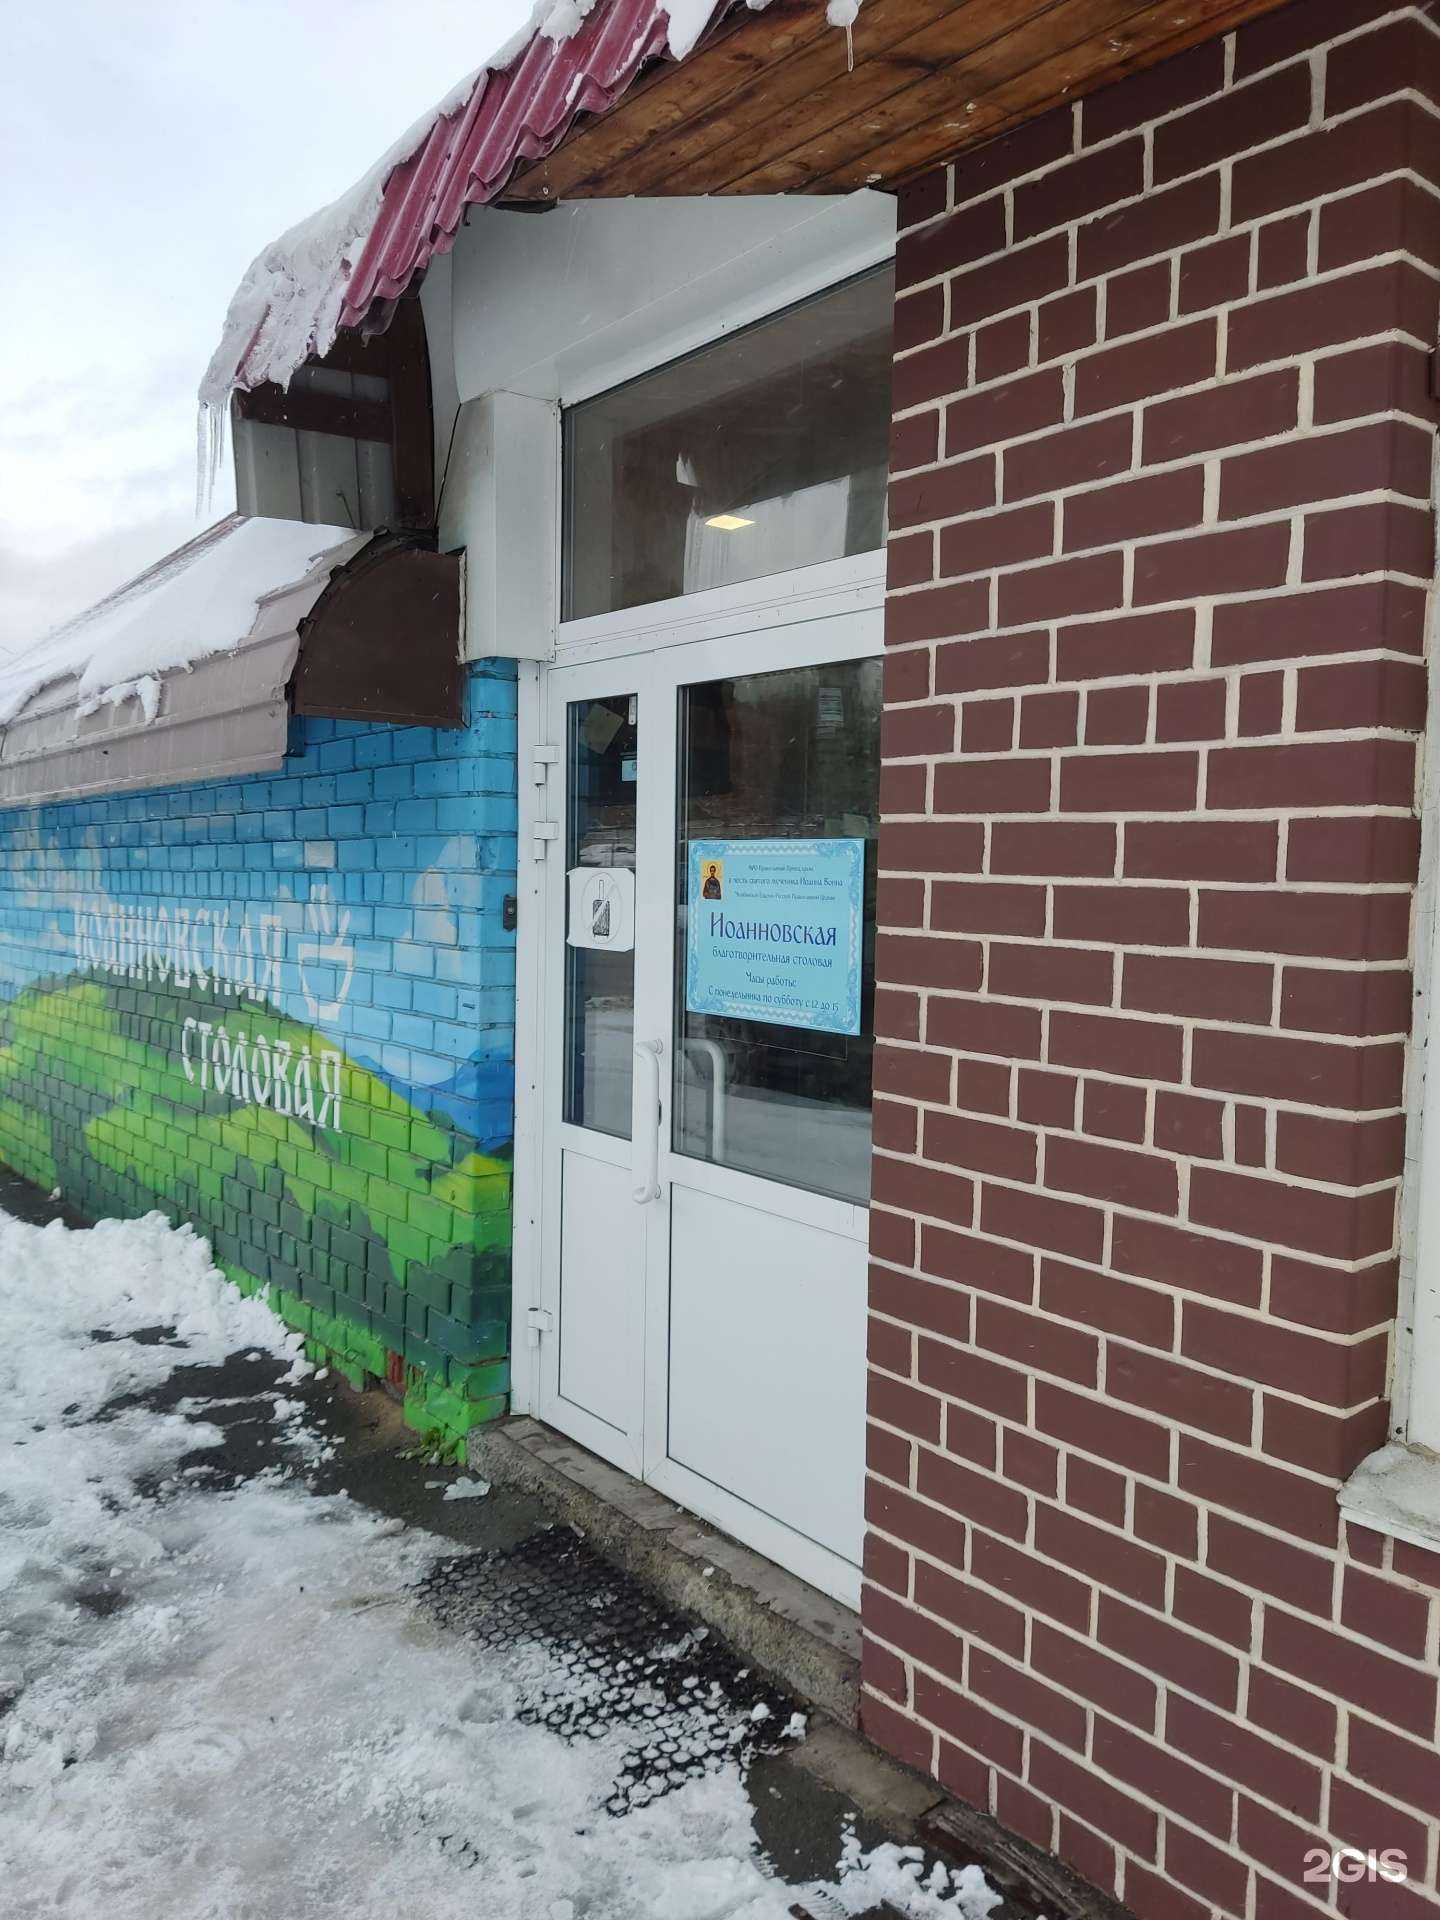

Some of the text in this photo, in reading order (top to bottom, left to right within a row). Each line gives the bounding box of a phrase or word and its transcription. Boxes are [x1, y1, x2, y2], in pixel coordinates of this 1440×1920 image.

[710, 911, 837, 947] Иоанновская
[74, 904, 283, 1007] ИОАННОВСКАЯ
[792, 955, 833, 969] столовая
[745, 970, 765, 984] Часы
[811, 999, 819, 1009] 12
[820, 1001, 831, 1012] до
[181, 1017, 344, 1133] СТОЛОВАЯ
